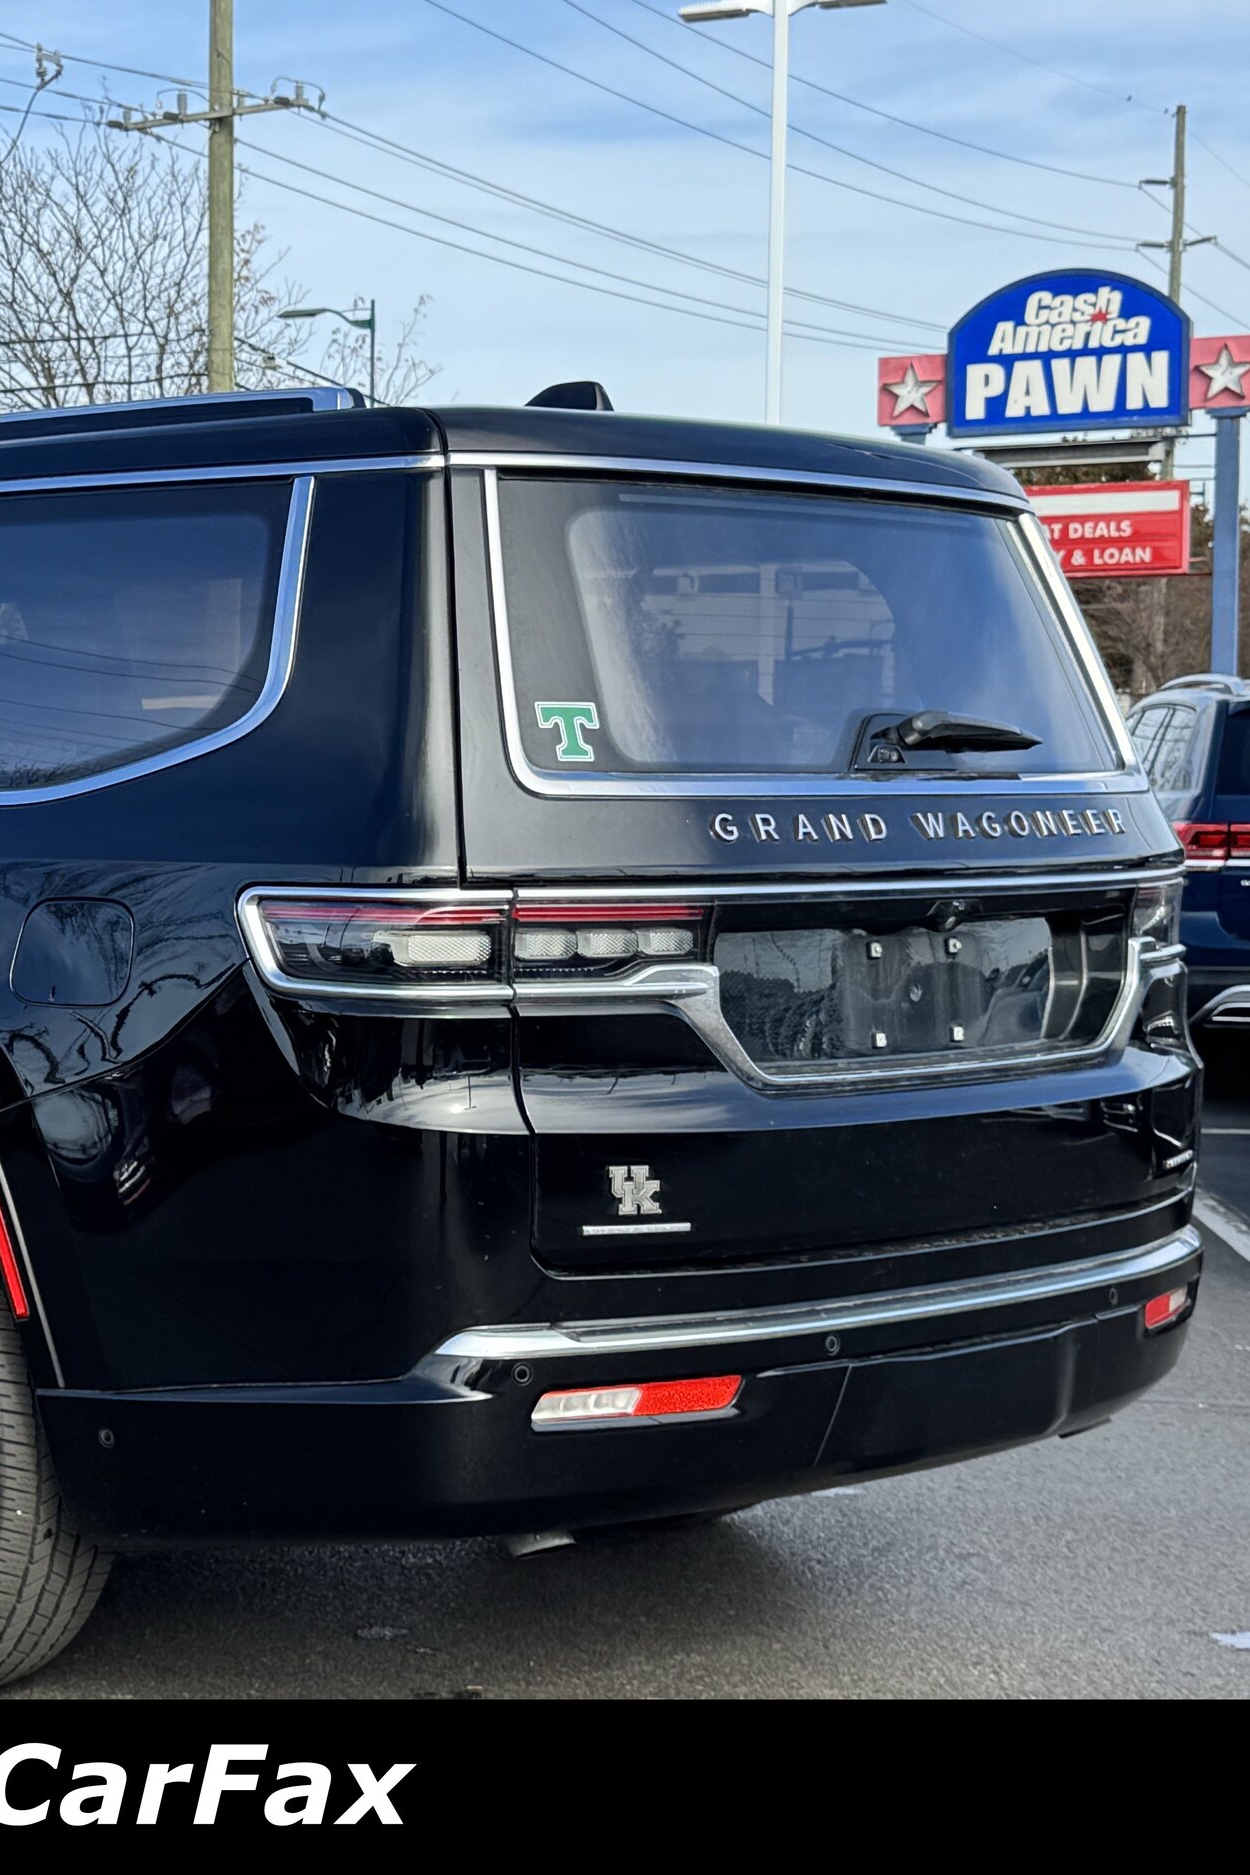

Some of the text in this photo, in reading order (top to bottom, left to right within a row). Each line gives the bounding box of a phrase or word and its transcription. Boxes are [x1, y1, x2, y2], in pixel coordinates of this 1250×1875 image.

[1024, 286, 1123, 326] Cash
[987, 315, 1151, 356] America
[965, 350, 1170, 420] PAWN
[1068, 520, 1132, 539] DEALS
[1070, 549, 1086, 566] &
[1093, 547, 1152, 565] LOAN
[535, 701, 599, 762] T
[710, 808, 1126, 843] GRAND WAGONEER
[608, 1165, 662, 1216] UK
